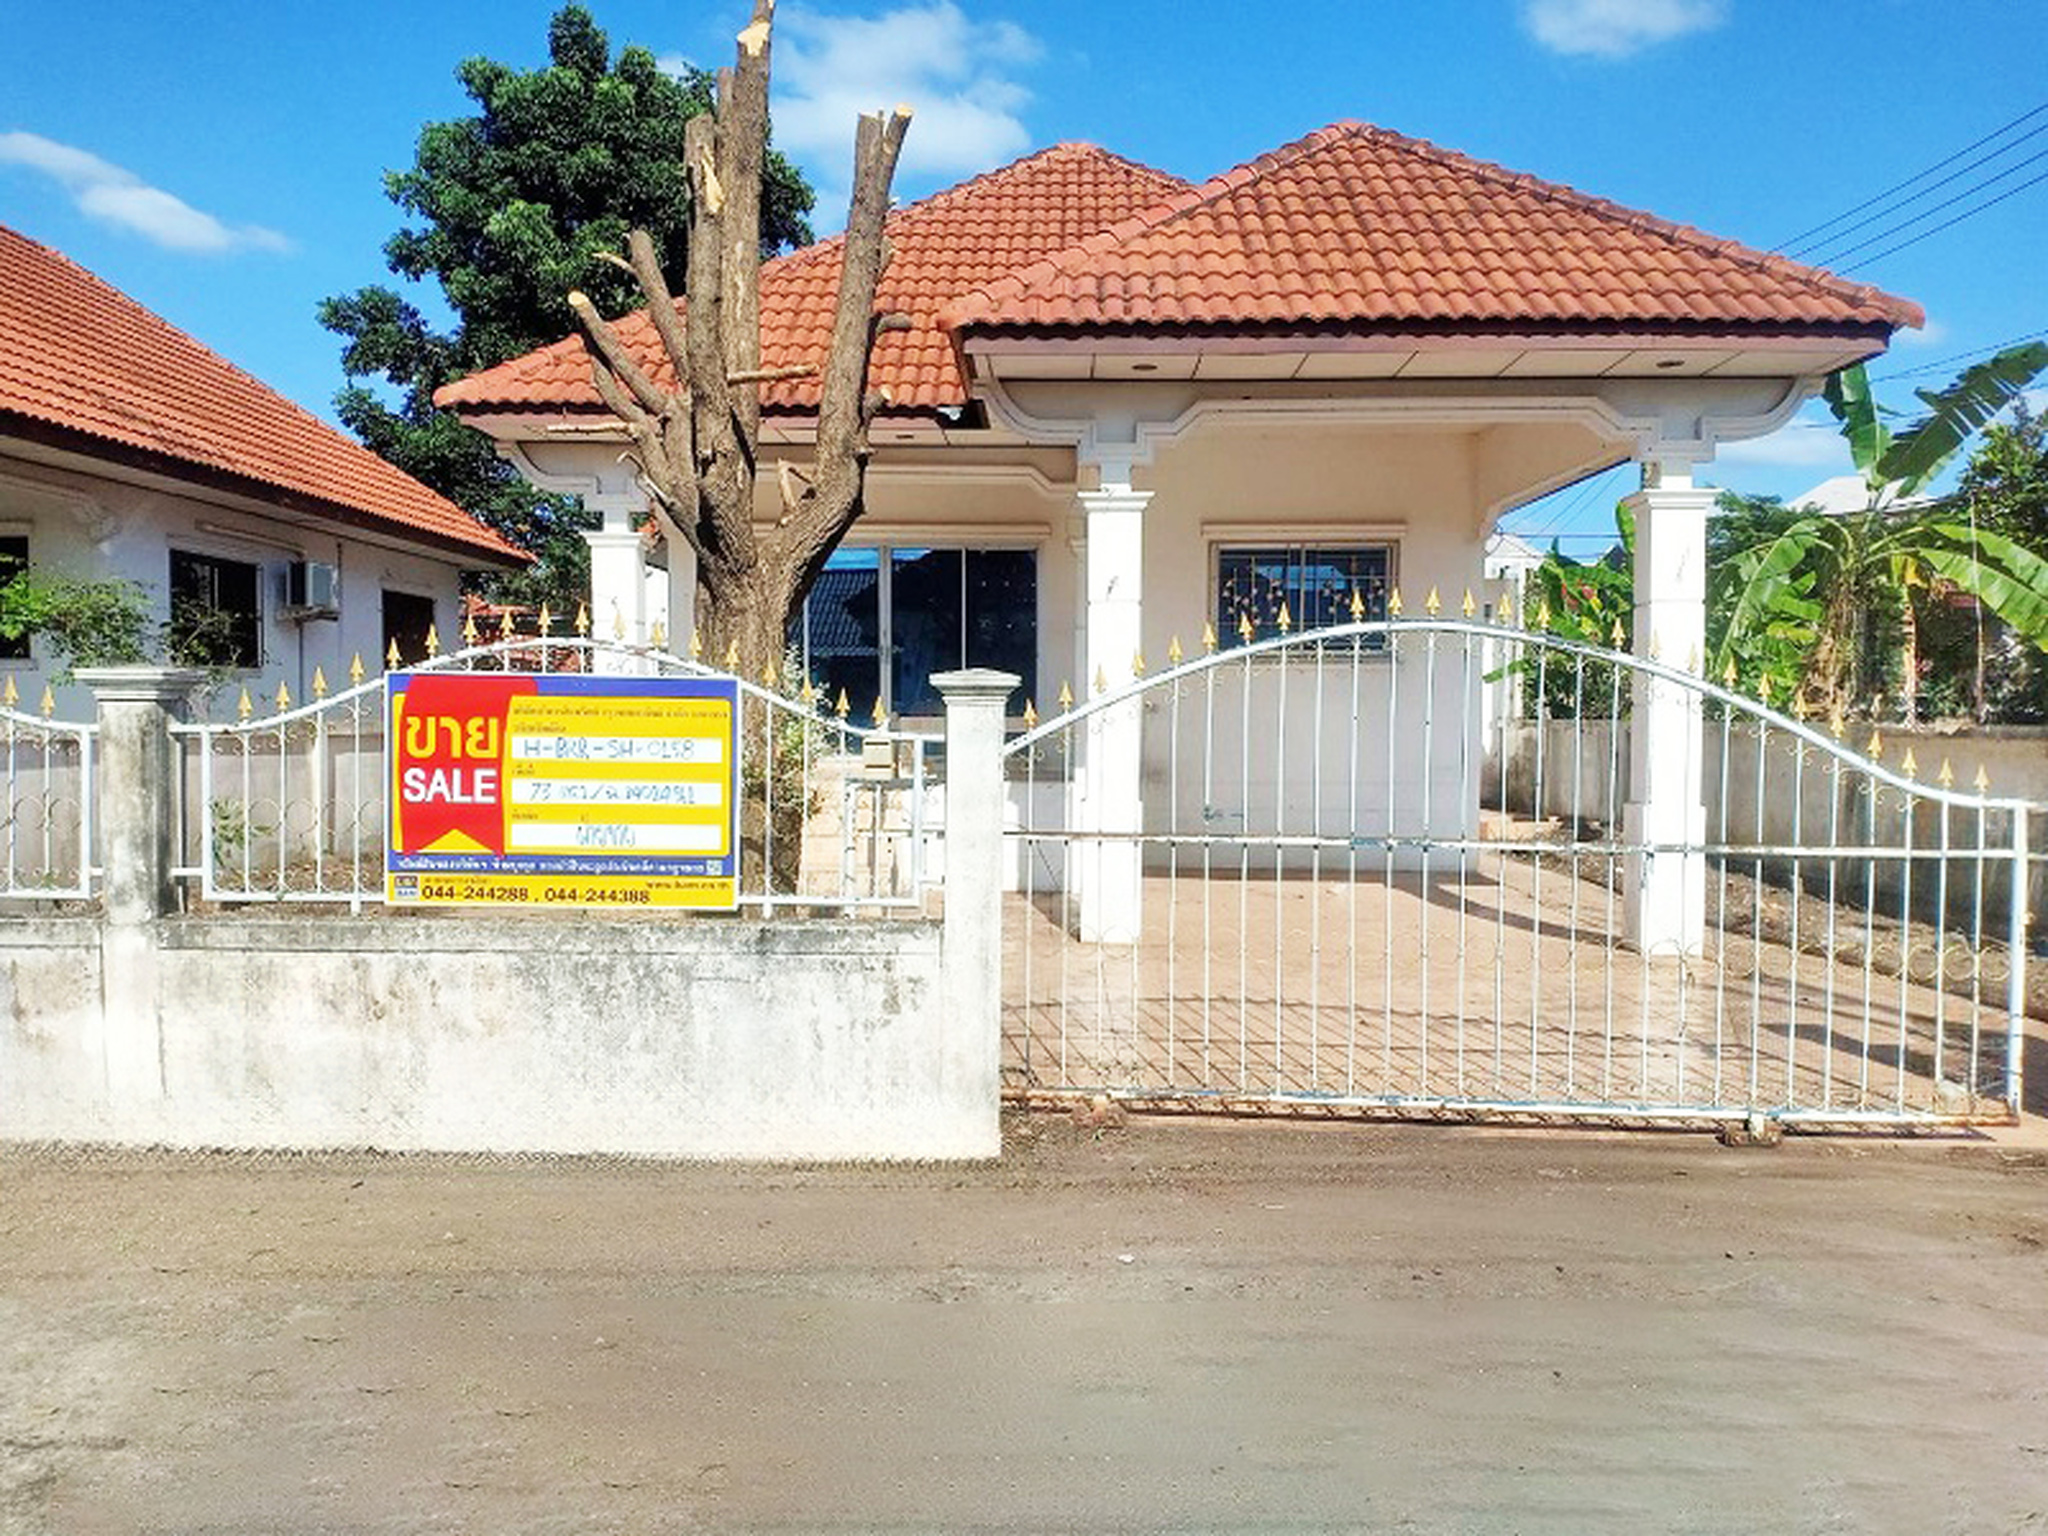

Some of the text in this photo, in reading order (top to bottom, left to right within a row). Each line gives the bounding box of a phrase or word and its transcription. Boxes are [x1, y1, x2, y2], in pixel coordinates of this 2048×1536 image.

[406, 716, 498, 758] ขาย
[403, 767, 497, 804] SALE
[422, 886, 529, 901] 044-244288
[544, 887, 650, 904] 044-244388
